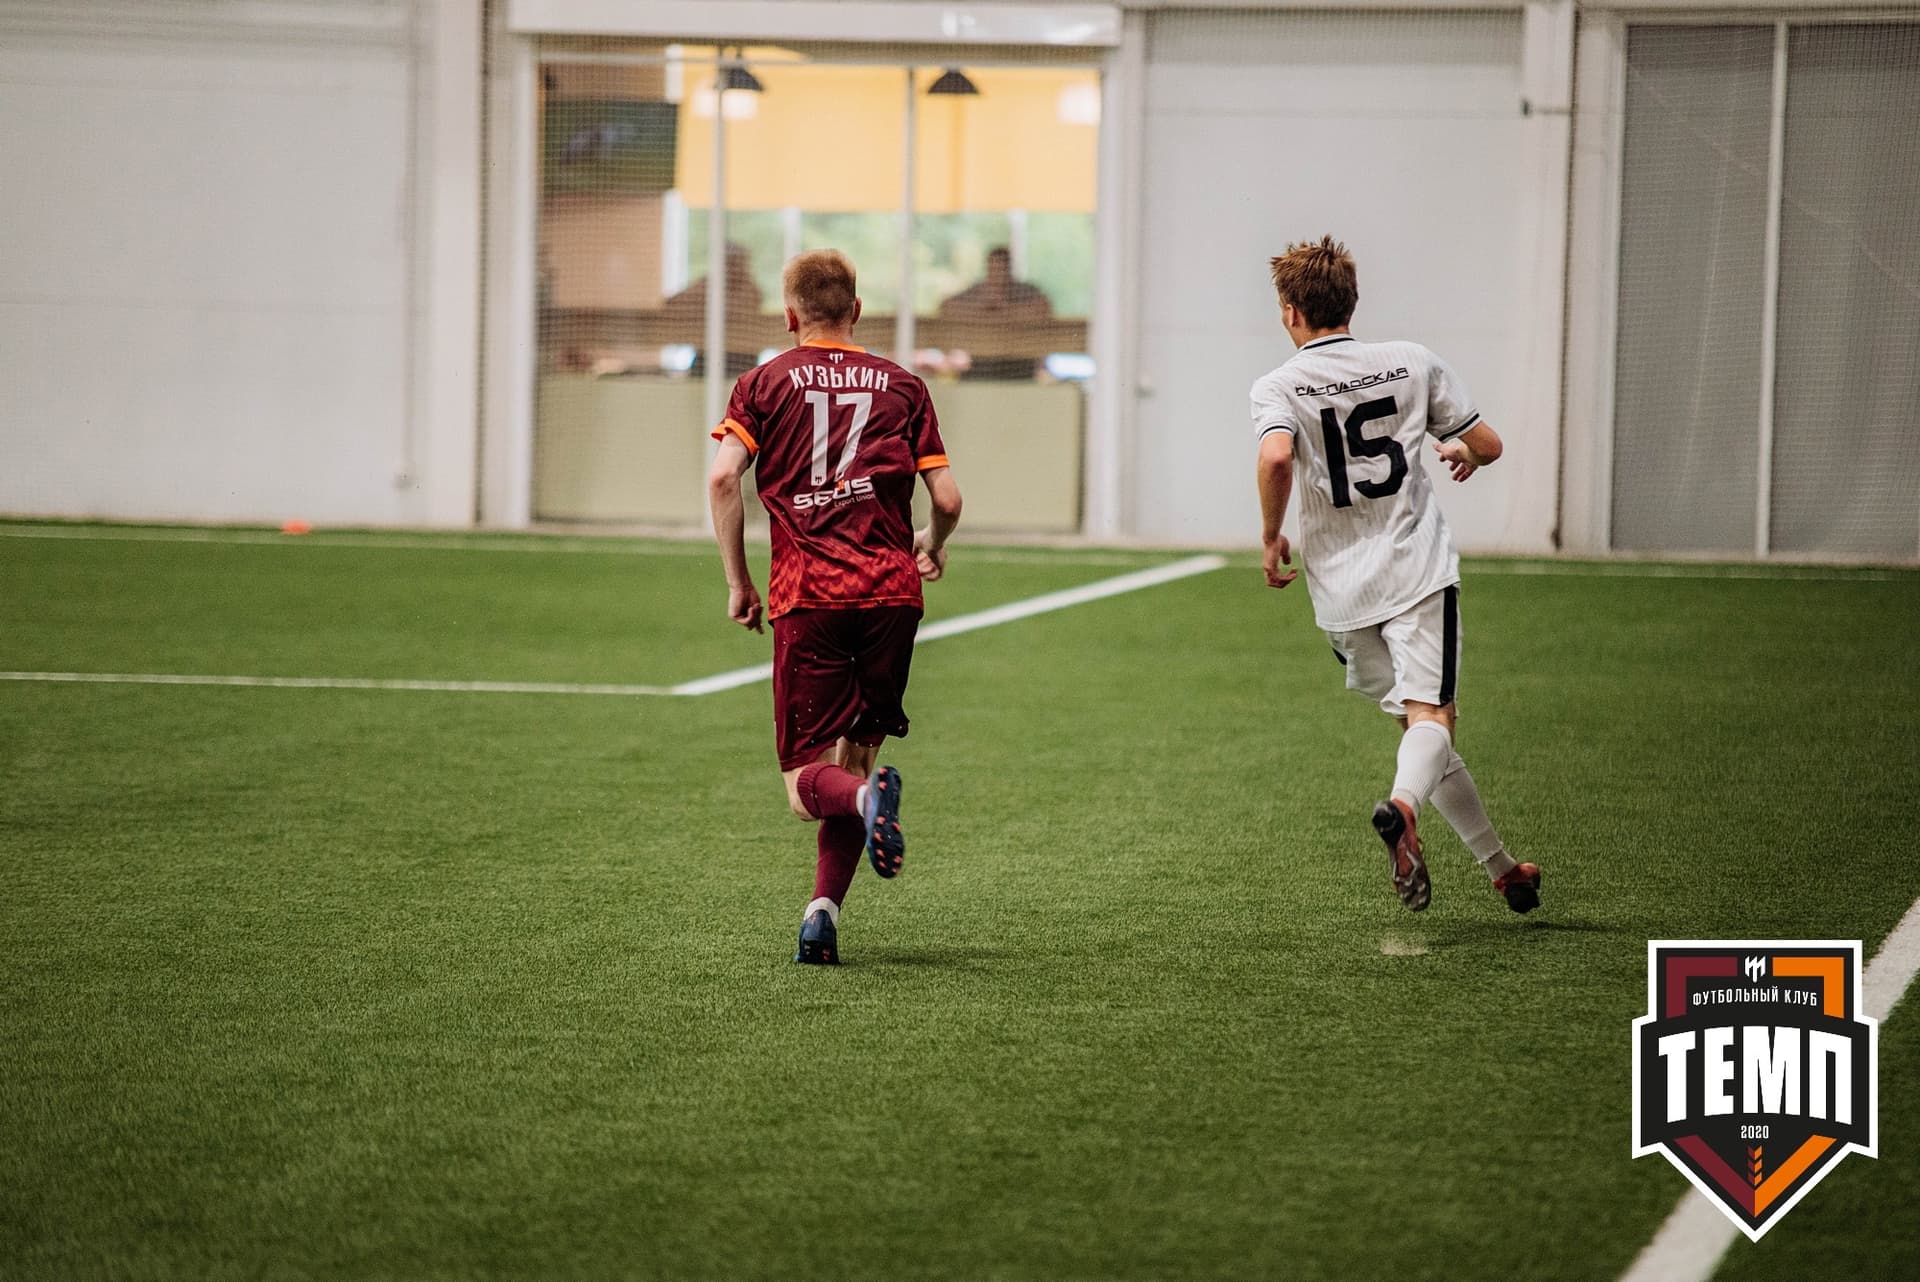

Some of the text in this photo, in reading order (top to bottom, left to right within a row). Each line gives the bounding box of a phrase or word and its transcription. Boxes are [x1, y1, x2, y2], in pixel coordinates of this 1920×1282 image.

[788, 364, 889, 392] КУЗЬКИН
[804, 390, 873, 487] 17
[1320, 395, 1409, 508] 15
[856, 493, 876, 502] Union
